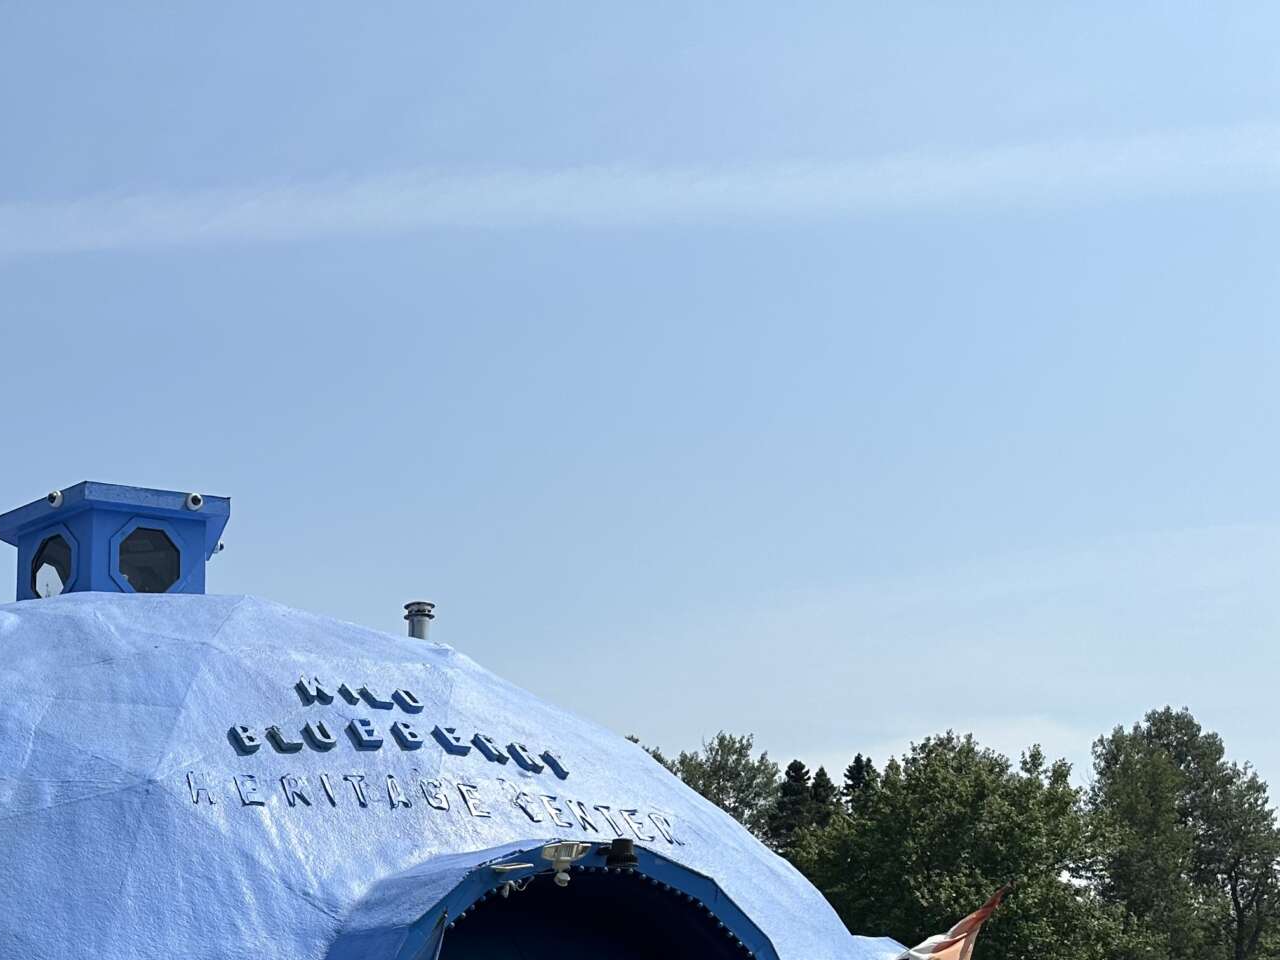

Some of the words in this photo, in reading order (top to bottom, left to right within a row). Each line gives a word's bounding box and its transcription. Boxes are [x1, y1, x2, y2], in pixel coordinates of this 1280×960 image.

[294, 675, 424, 714] WILD
[226, 718, 570, 780] BLUEBERRY
[186, 770, 492, 818] HERITAGE
[512, 791, 685, 847] CENTER
